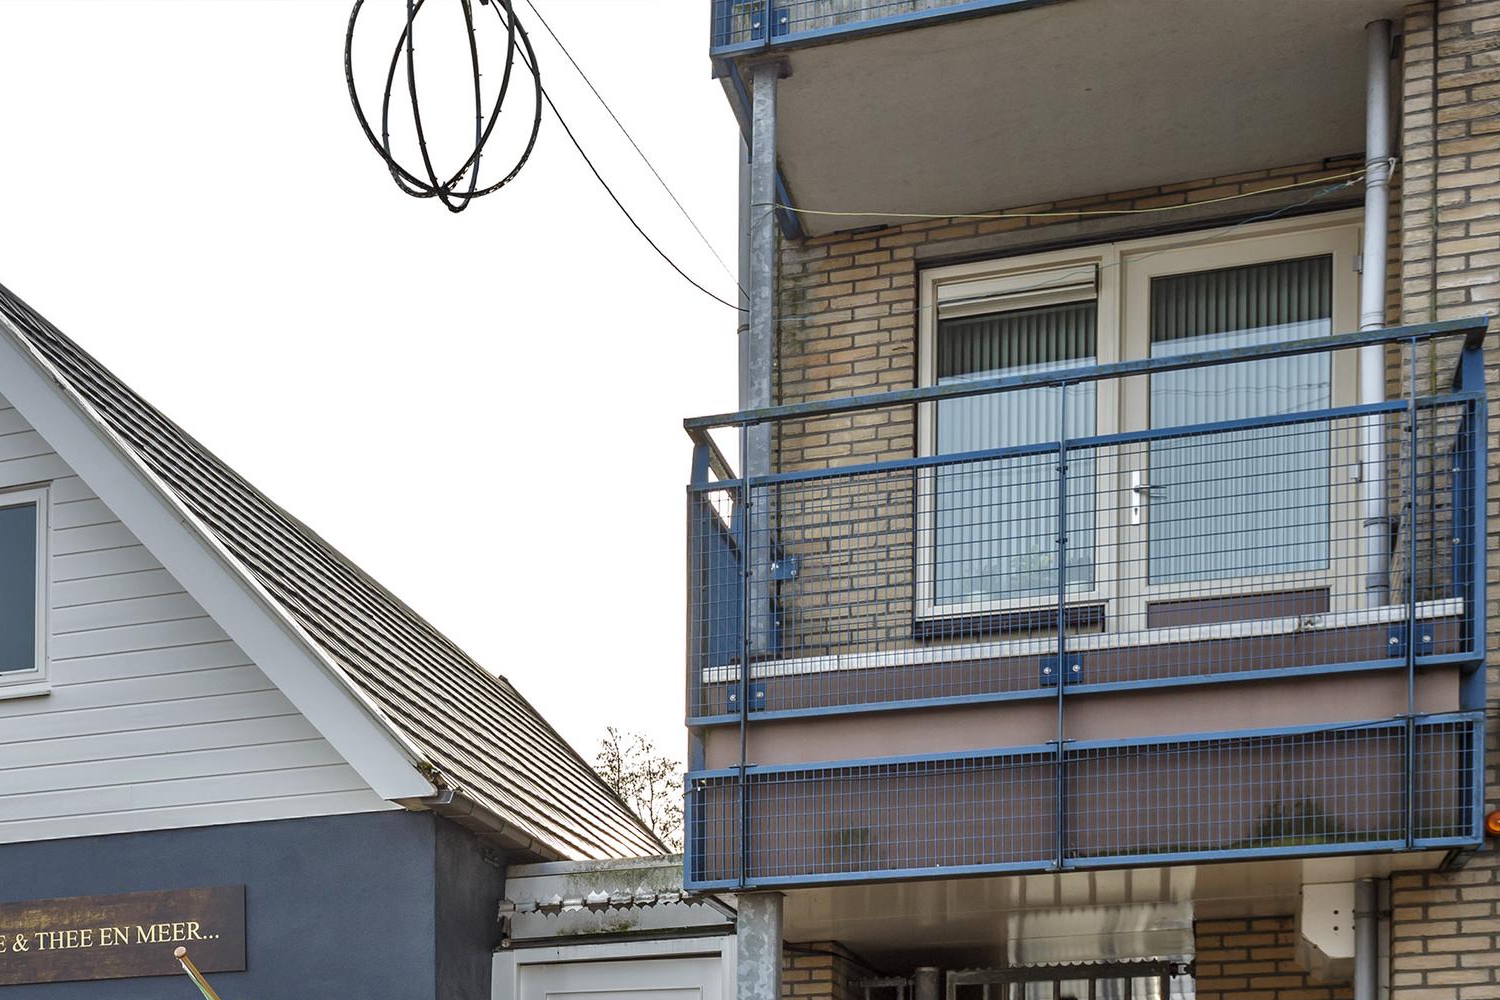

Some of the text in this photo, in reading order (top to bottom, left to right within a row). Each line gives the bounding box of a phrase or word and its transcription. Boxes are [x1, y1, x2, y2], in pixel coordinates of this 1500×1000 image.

[12, 933, 30, 952] &
[35, 928, 94, 951] THEE
[99, 926, 130, 947] EN
[135, 921, 220, 944] MEER...
